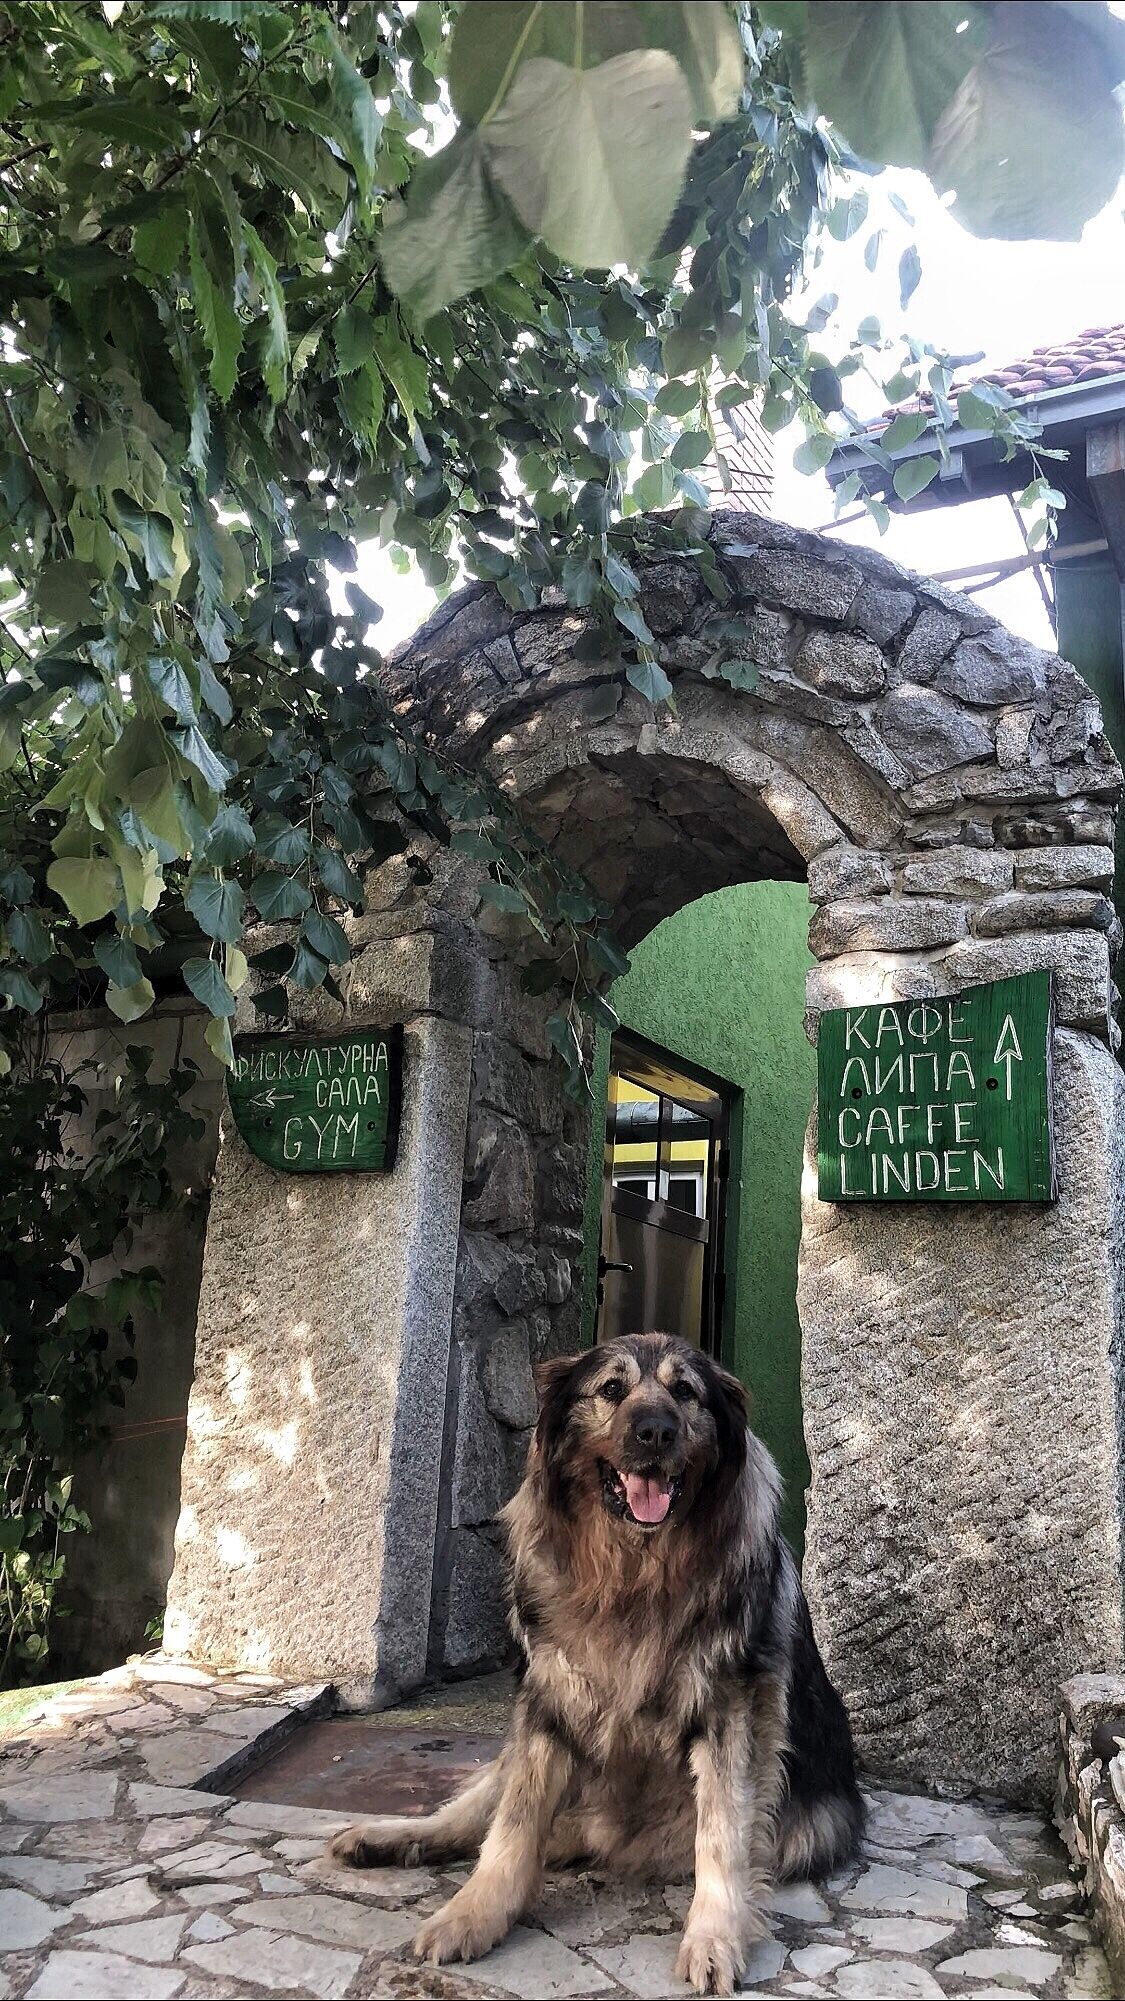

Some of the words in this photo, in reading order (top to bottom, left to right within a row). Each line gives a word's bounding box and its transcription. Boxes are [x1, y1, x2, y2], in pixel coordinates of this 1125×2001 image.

[845, 1001, 974, 1050] КАФЕ
[316, 1075, 381, 1108] САЛА
[840, 1050, 976, 1096] ЛИПА
[283, 1112, 359, 1160] GYM
[838, 1101, 980, 1148] CAFFE
[840, 1147, 1005, 1195] LINDEN
